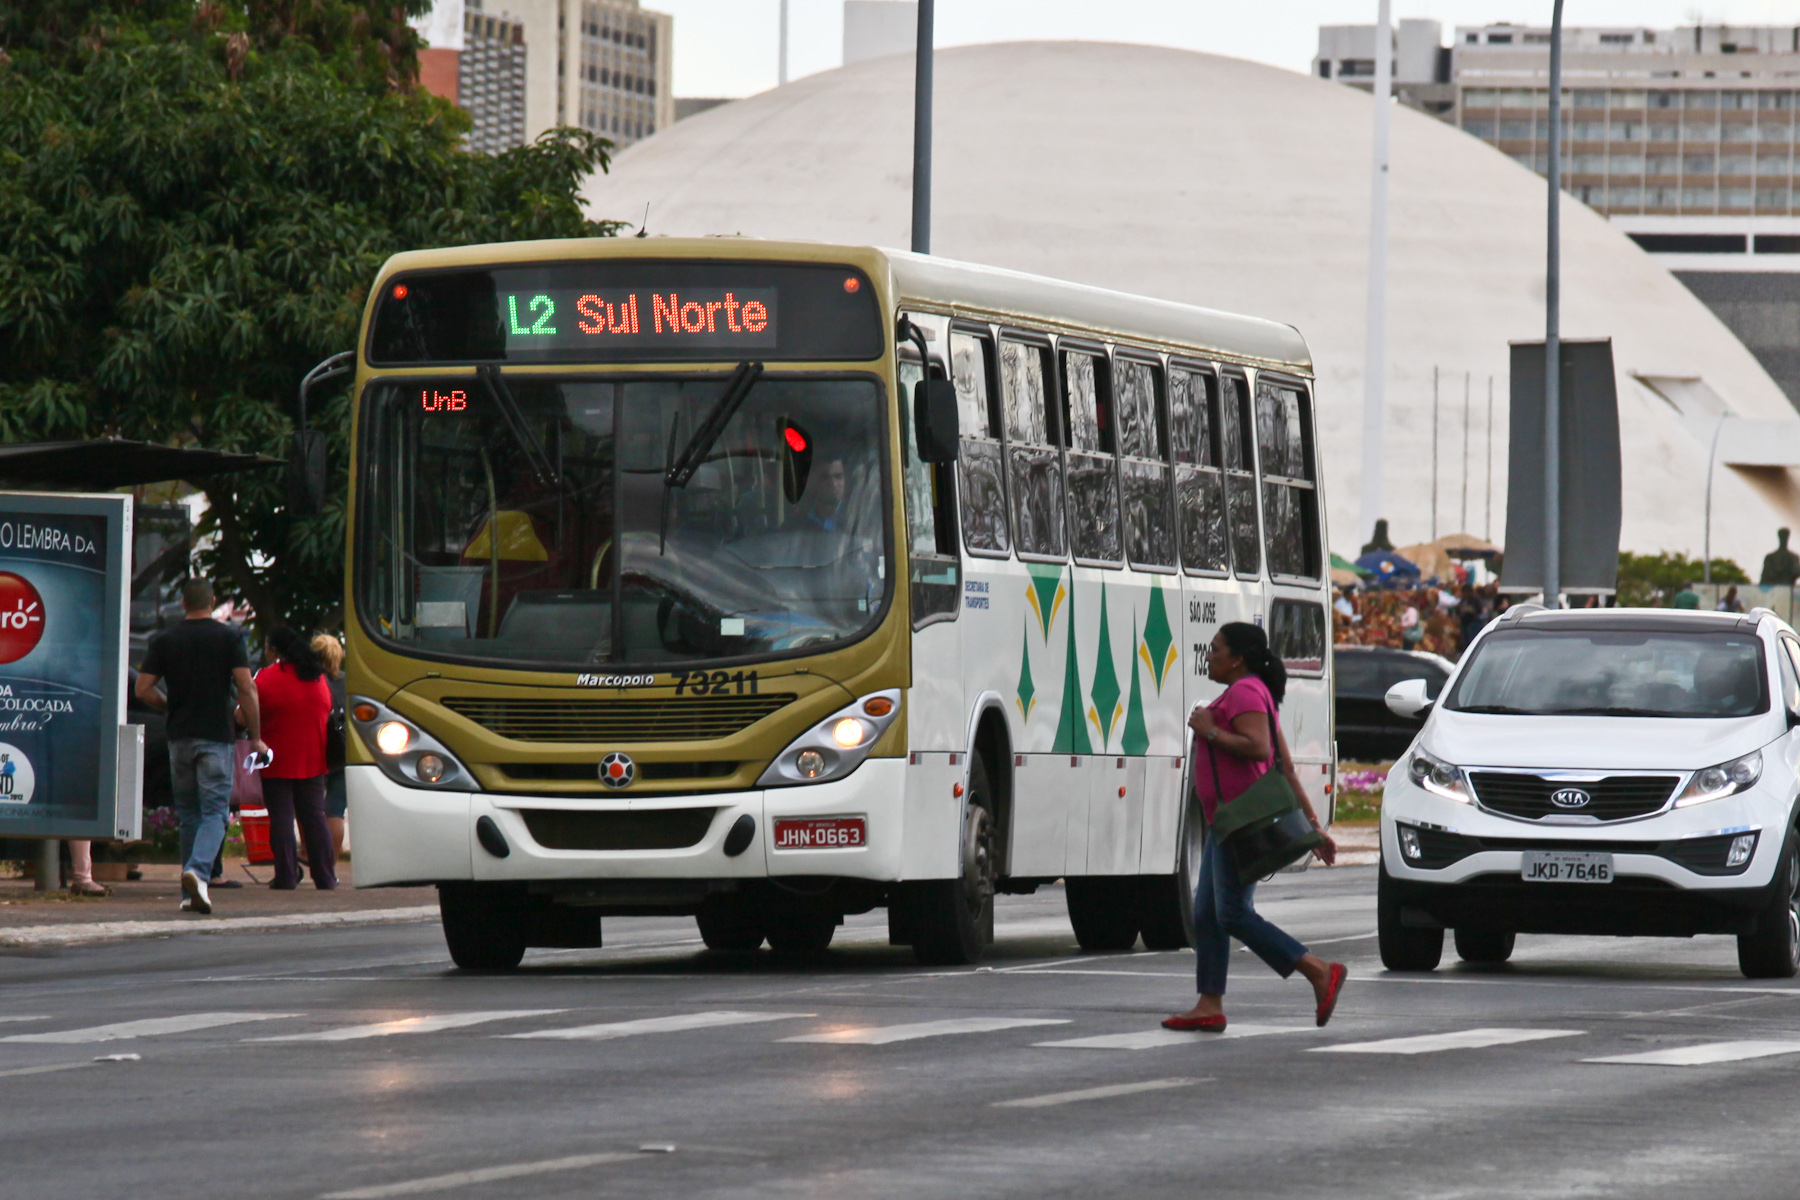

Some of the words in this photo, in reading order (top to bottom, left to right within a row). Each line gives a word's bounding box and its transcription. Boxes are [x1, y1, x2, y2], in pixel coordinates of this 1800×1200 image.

[508, 295, 557, 335] L2
[576, 293, 640, 334] Sul
[652, 292, 769, 334] Norte
[422, 390, 467, 412] UnB
[17, 524, 71, 551] LEMBRA
[75, 535, 96, 554] DA
[1190, 595, 1201, 623] SÃO
[1202, 596, 1216, 624] JOSÉ
[1194, 643, 1212, 676] 732
[576, 673, 654, 687] Marcopolo
[671, 670, 758, 696] 73211
[1557, 792, 1584, 804] KIA
[778, 828, 860, 845] JHN-0663
